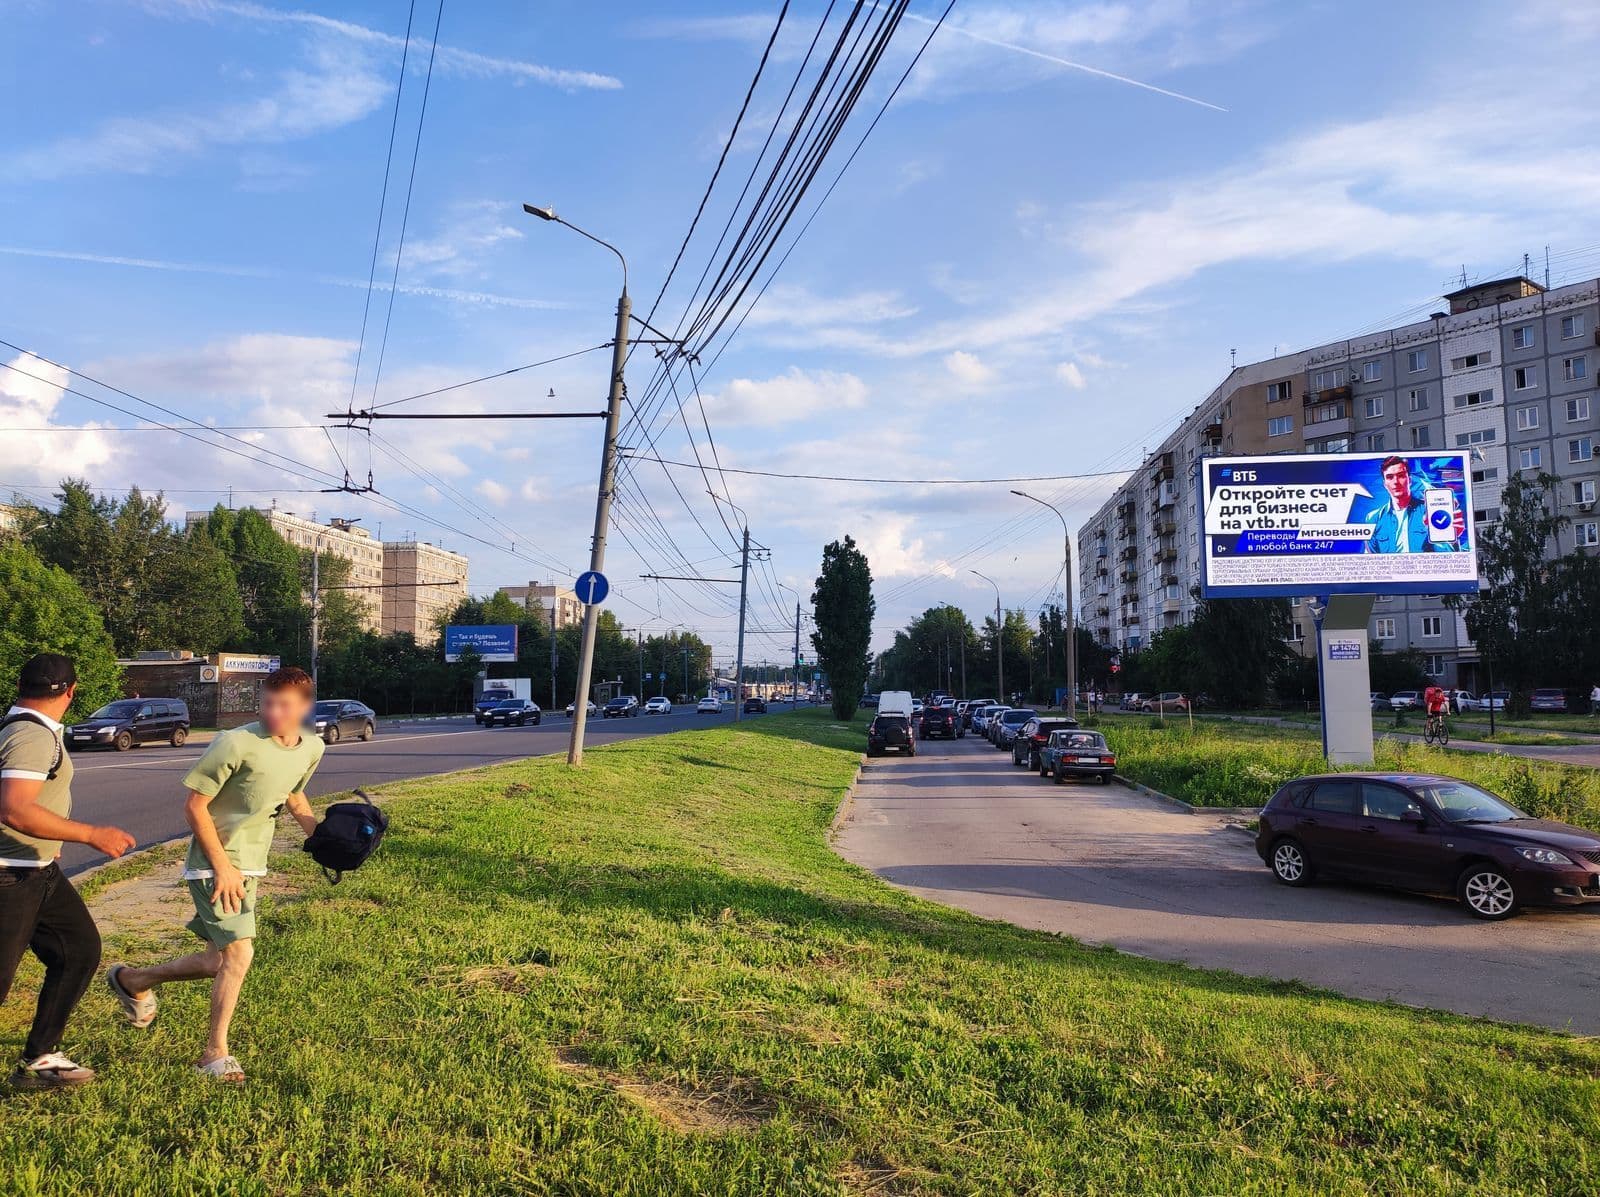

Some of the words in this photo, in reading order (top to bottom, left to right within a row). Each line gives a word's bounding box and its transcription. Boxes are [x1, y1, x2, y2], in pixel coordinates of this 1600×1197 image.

[1232, 470, 1257, 482] ВТБ
[1219, 486, 1306, 503] Откройте
[1310, 487, 1348, 499] счет
[1219, 505, 1252, 517] для
[1257, 500, 1328, 514] бизнеса
[1220, 519, 1242, 530] на
[1247, 516, 1299, 529] vtb.ru
[1247, 532, 1296, 541] Переводы
[1301, 528, 1371, 538] мгновенно
[1255, 542, 1287, 551] любой
[1289, 541, 1312, 550] банк
[1314, 541, 1334, 550] 24/7
